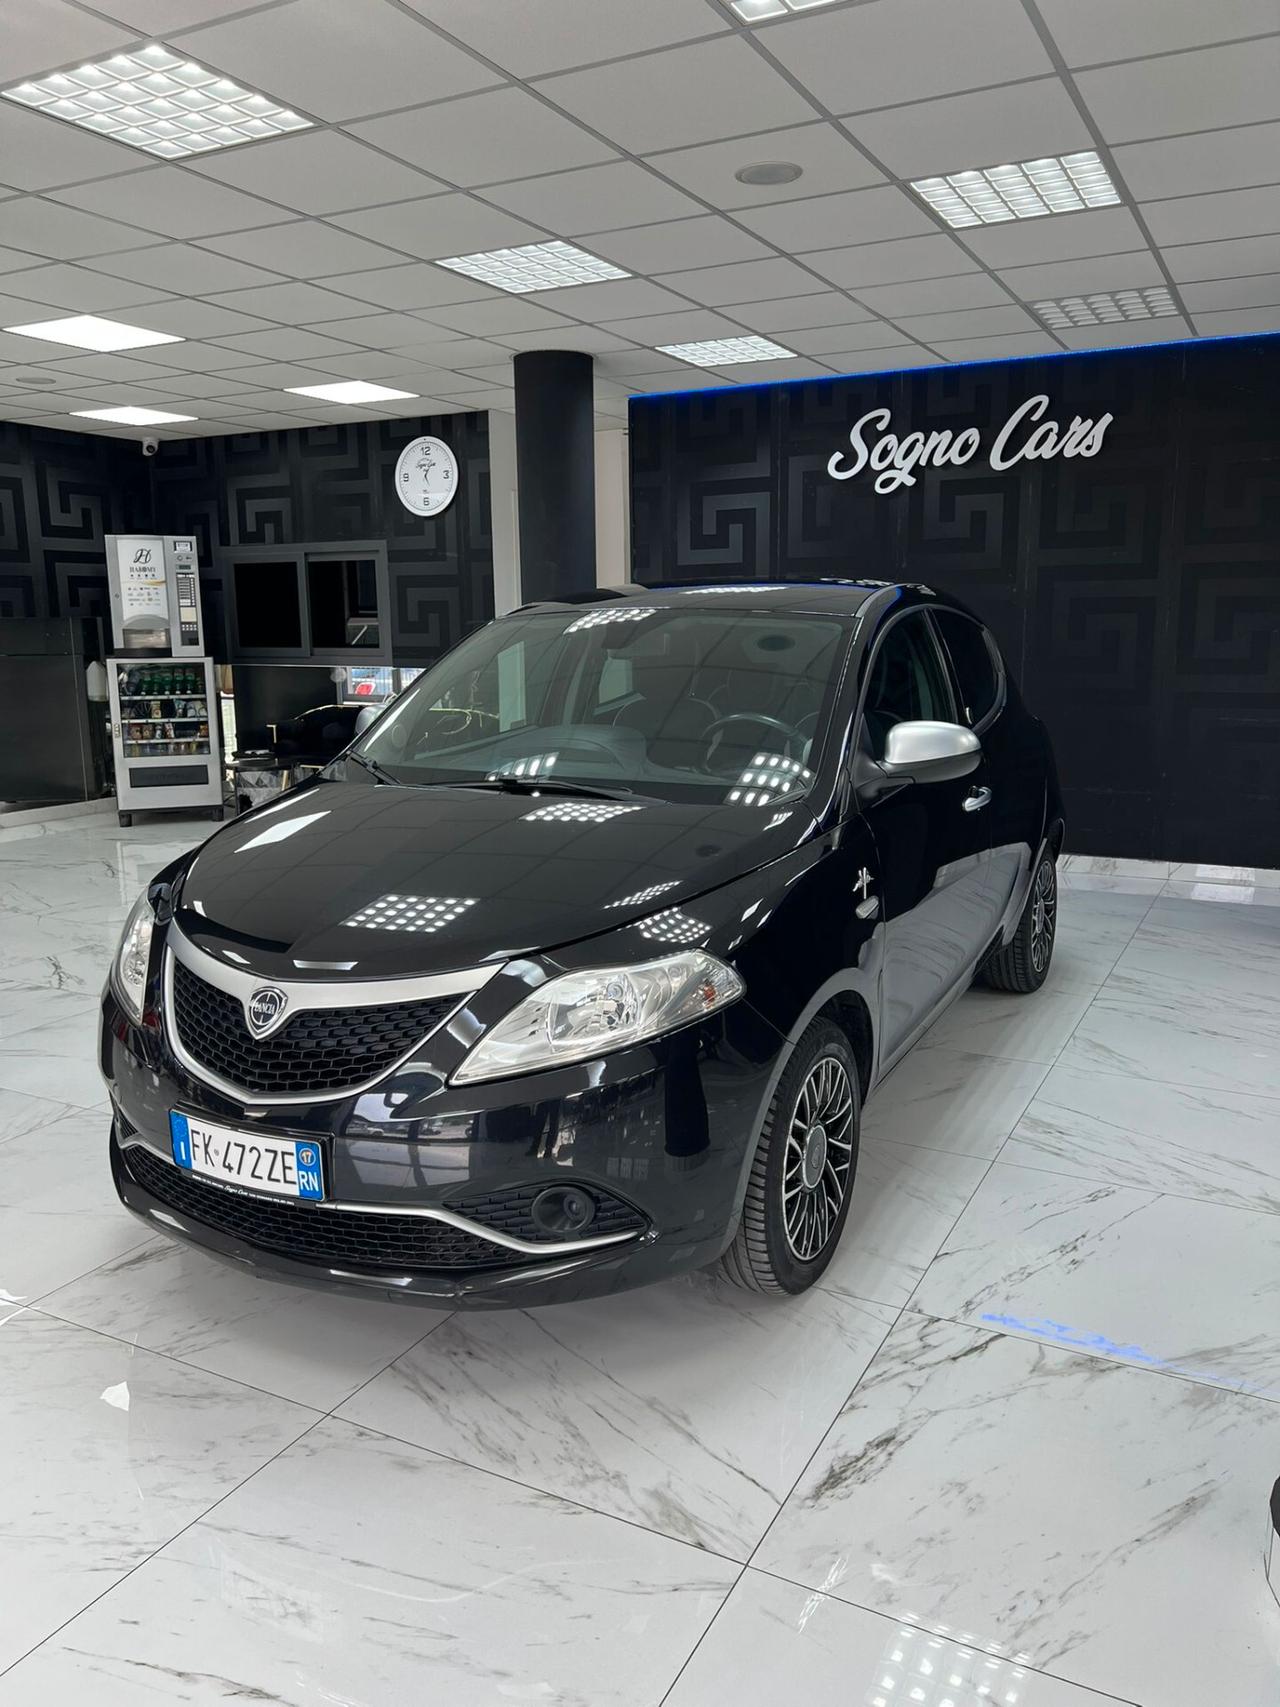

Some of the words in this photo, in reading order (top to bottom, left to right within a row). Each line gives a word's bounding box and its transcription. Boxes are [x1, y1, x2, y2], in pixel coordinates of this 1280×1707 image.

[827, 408, 980, 494] Sogno
[989, 394, 1114, 471] Cars
[421, 446, 431, 456] 12
[403, 473, 409, 482] 9
[443, 470, 450, 480] 3
[424, 497, 430, 506] 6
[253, 1001, 276, 1015] LANCIA
[190, 1128, 216, 1168] FK
[222, 1140, 298, 1186] 472ZE
[301, 1151, 312, 1164] 17
[299, 1170, 320, 1193] RN
